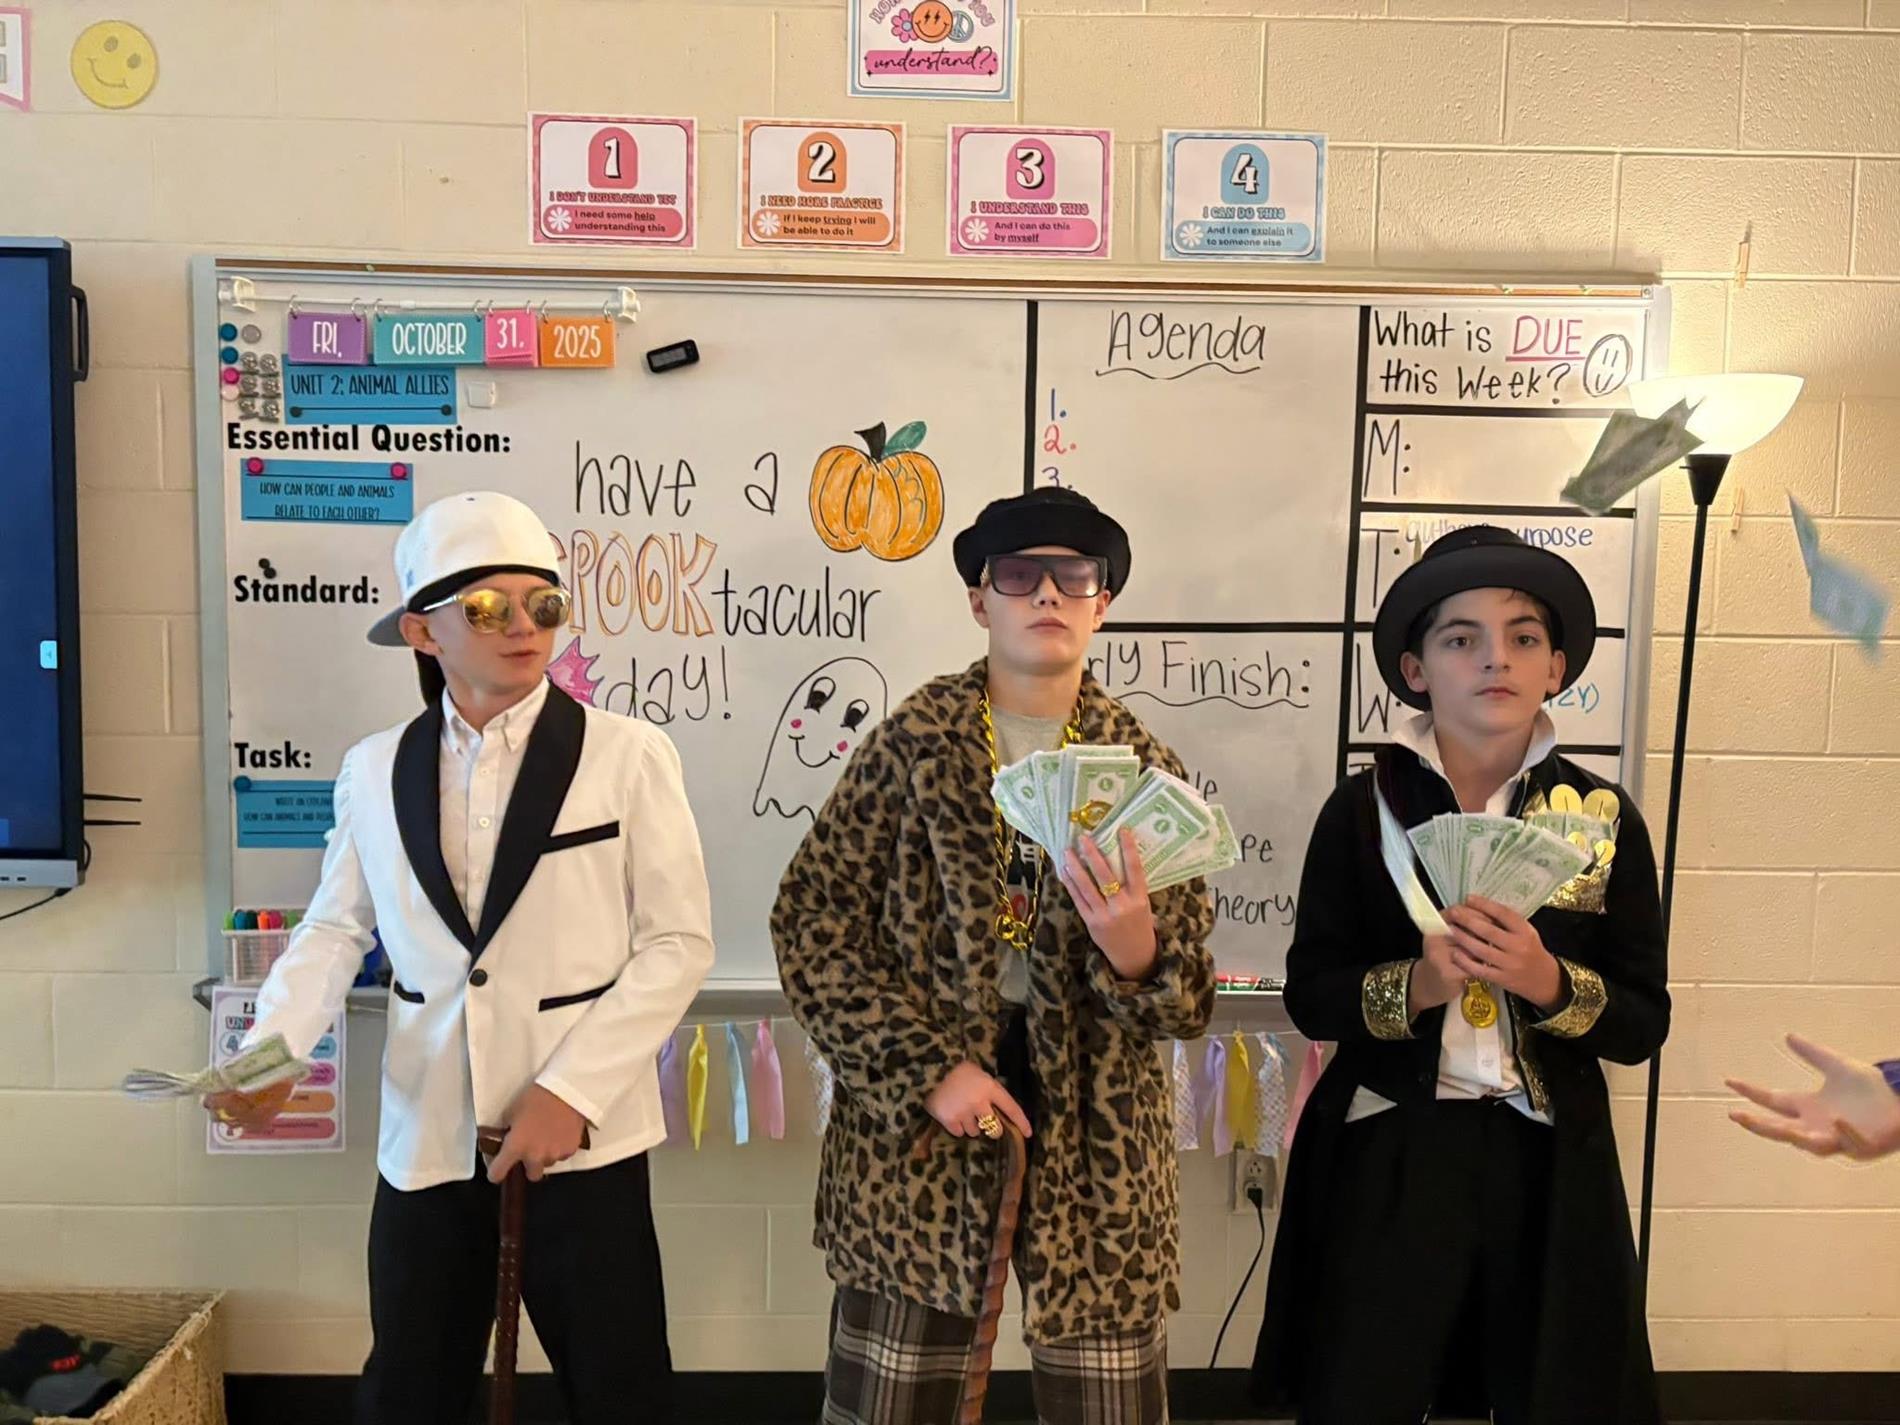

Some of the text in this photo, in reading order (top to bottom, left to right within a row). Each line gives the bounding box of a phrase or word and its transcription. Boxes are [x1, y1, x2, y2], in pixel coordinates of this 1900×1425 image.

[874, 46, 992, 71] understand?
[604, 137, 622, 180] 1
[807, 140, 837, 184] 2
[1015, 147, 1045, 190] 3
[1230, 153, 1260, 195] 4
[588, 192, 656, 204] UNDERSTAND
[760, 195, 883, 209] I NEED MORE PRACTICE
[971, 201, 1089, 215] I UNDERSTAND THIS
[575, 222, 666, 233] understanding this
[606, 212, 632, 220] some
[634, 211, 656, 221] help
[783, 214, 791, 222] If
[798, 215, 821, 225] keep
[823, 216, 853, 226] trying
[994, 222, 1014, 230] And
[1039, 222, 1050, 230] do
[1053, 223, 1070, 231] this
[1202, 206, 1286, 220] I CAN DO THIS
[783, 226, 795, 234] be
[820, 227, 831, 235] to
[994, 233, 1039, 243] by myself
[1207, 226, 1225, 235] And
[1251, 227, 1284, 237] explain
[1286, 227, 1293, 235] it
[312, 317, 602, 359] FRI. OCTOBER 31. 2025
[1107, 309, 1266, 367] Agenda
[1374, 310, 1584, 356] What is DUE
[290, 374, 449, 396] UNIT 2: ANIMAL ALLIES
[1380, 358, 1571, 405] this Week?
[1051, 388, 1067, 421] 1.
[227, 422, 511, 453] Essential Question:
[1044, 424, 1077, 454] 2.
[1363, 419, 1411, 497] M:
[260, 482, 395, 498] HOW CAN PEOPLE AND ANIMALS
[576, 440, 778, 517] have a
[275, 504, 380, 520] RELATE TO EACH OTHER?
[1516, 526, 1594, 549] urpose
[233, 575, 380, 604] Standard:
[547, 528, 883, 643] POOK tacular
[1087, 640, 1311, 697] rly Finish:
[605, 645, 732, 725] day!
[234, 741, 311, 769] Task:
[1210, 886, 1296, 926] heory
